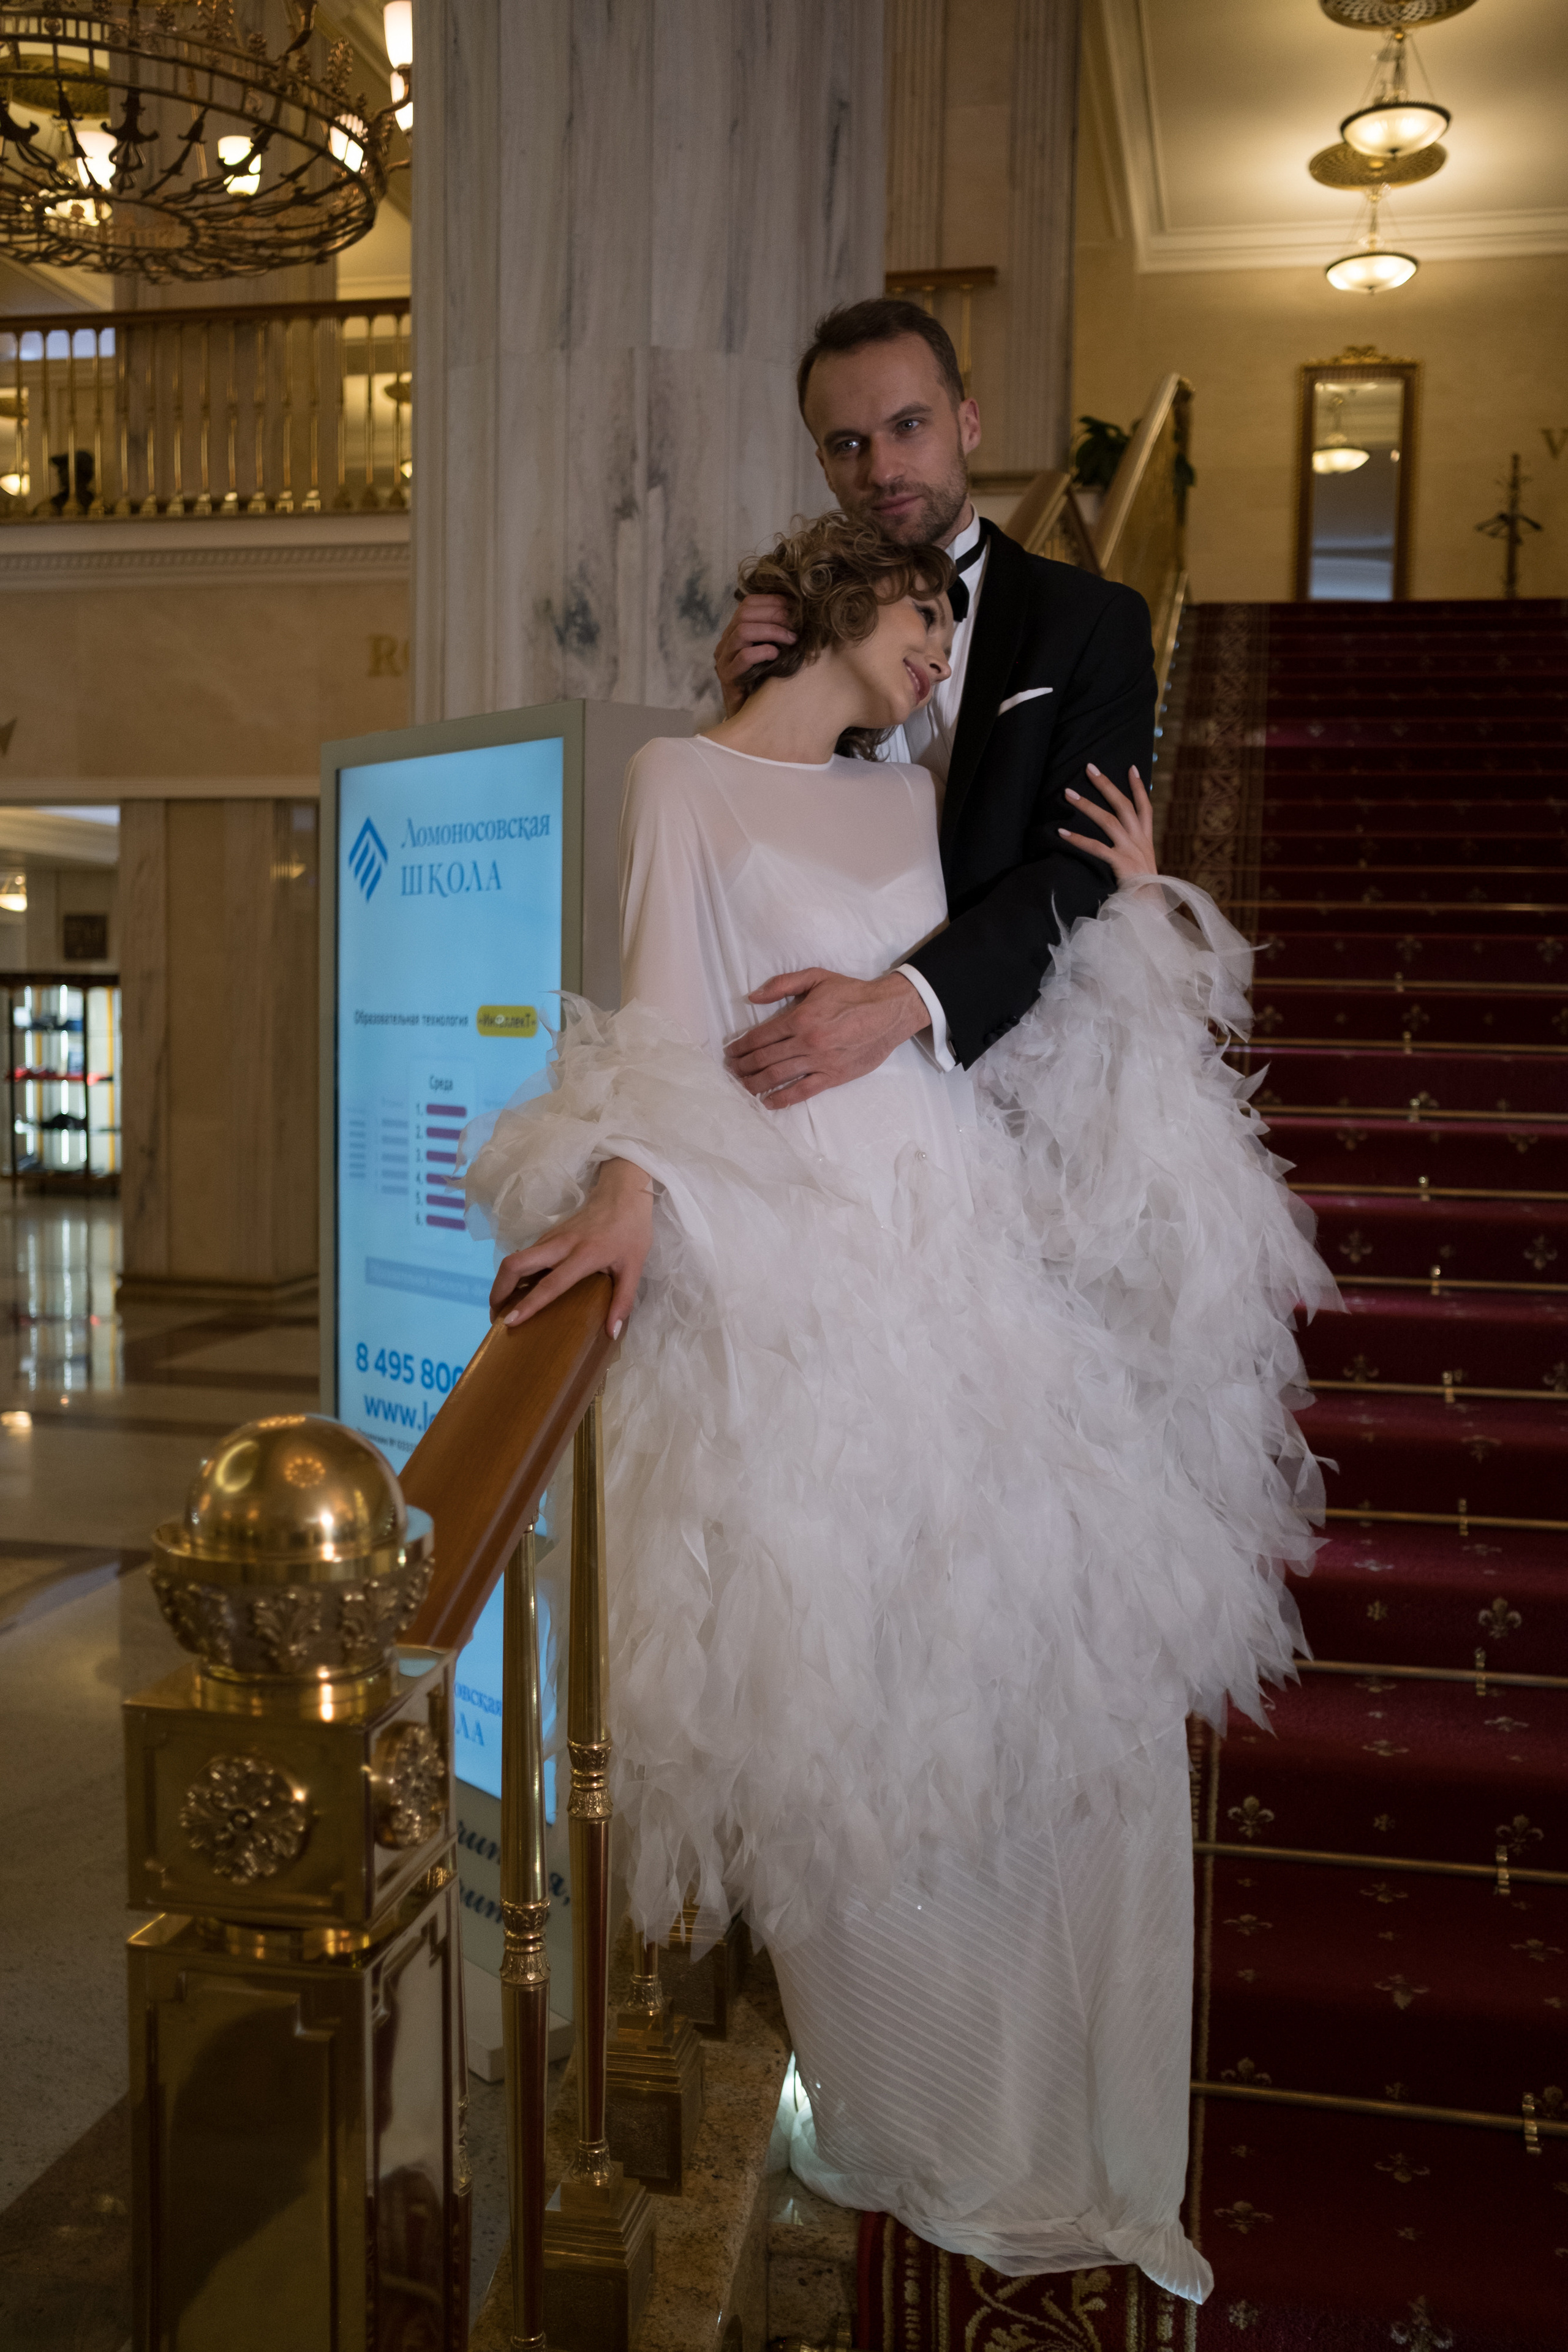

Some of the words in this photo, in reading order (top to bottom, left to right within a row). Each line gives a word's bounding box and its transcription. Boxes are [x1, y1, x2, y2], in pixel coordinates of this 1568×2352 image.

[400, 813, 551, 850] Ломоносовская
[401, 859, 503, 898] ШКОЛА
[421, 1013, 469, 1028] технология
[429, 1074, 454, 1093] Среда
[356, 1342, 369, 1373] 8
[374, 1348, 415, 1384] 495
